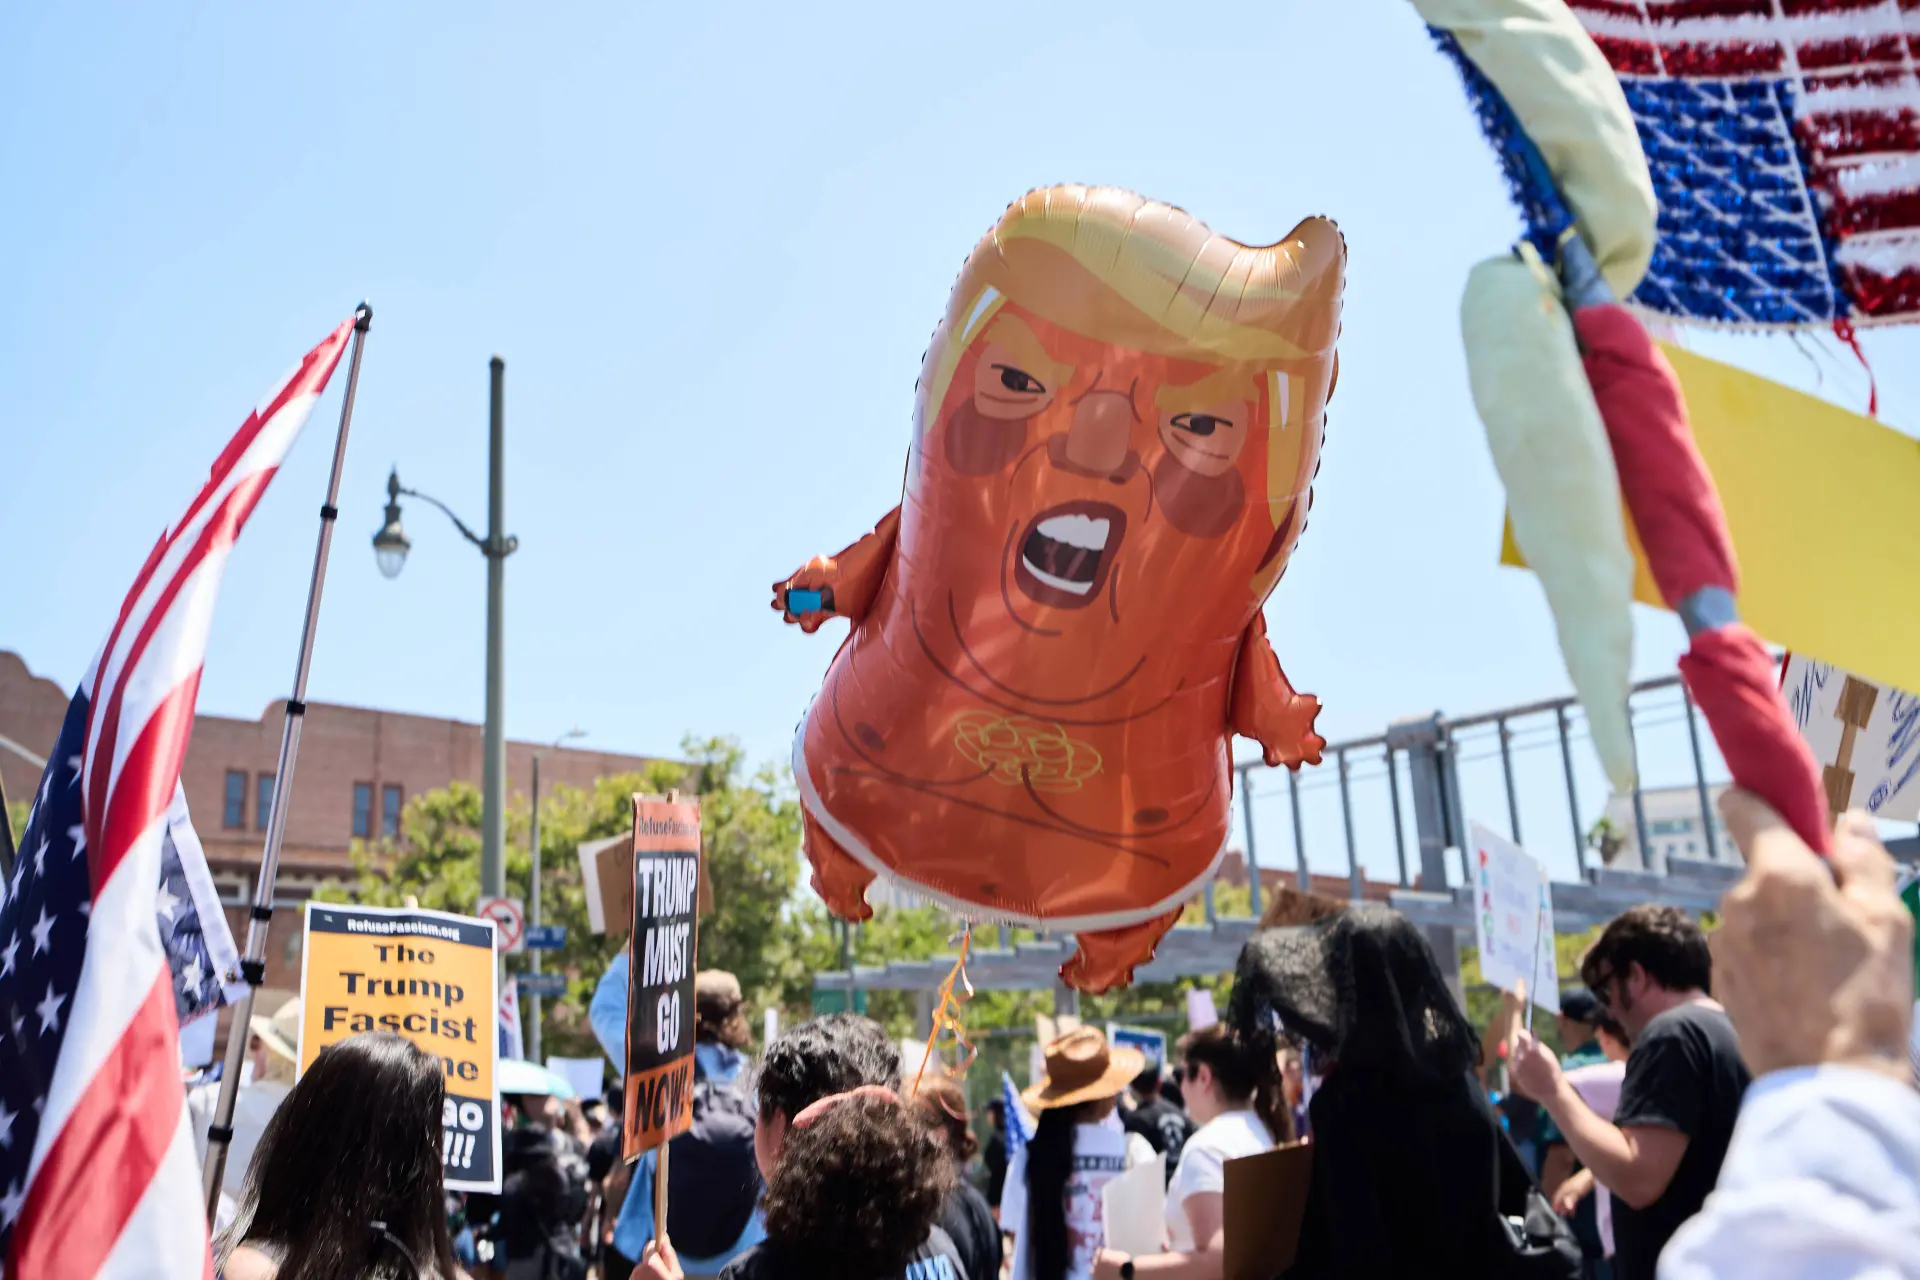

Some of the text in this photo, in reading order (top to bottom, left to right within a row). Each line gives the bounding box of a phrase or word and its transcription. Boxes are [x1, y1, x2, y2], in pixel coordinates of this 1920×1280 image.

[638, 857, 697, 918] TRUMP
[347, 918, 461, 942] RefuseFascism.org
[373, 943, 435, 965] The
[643, 922, 689, 988] MUST
[339, 971, 465, 1008] Trump
[323, 1005, 478, 1044] Fascist
[657, 991, 680, 1055] GO
[633, 1065, 688, 1134] NOW!
